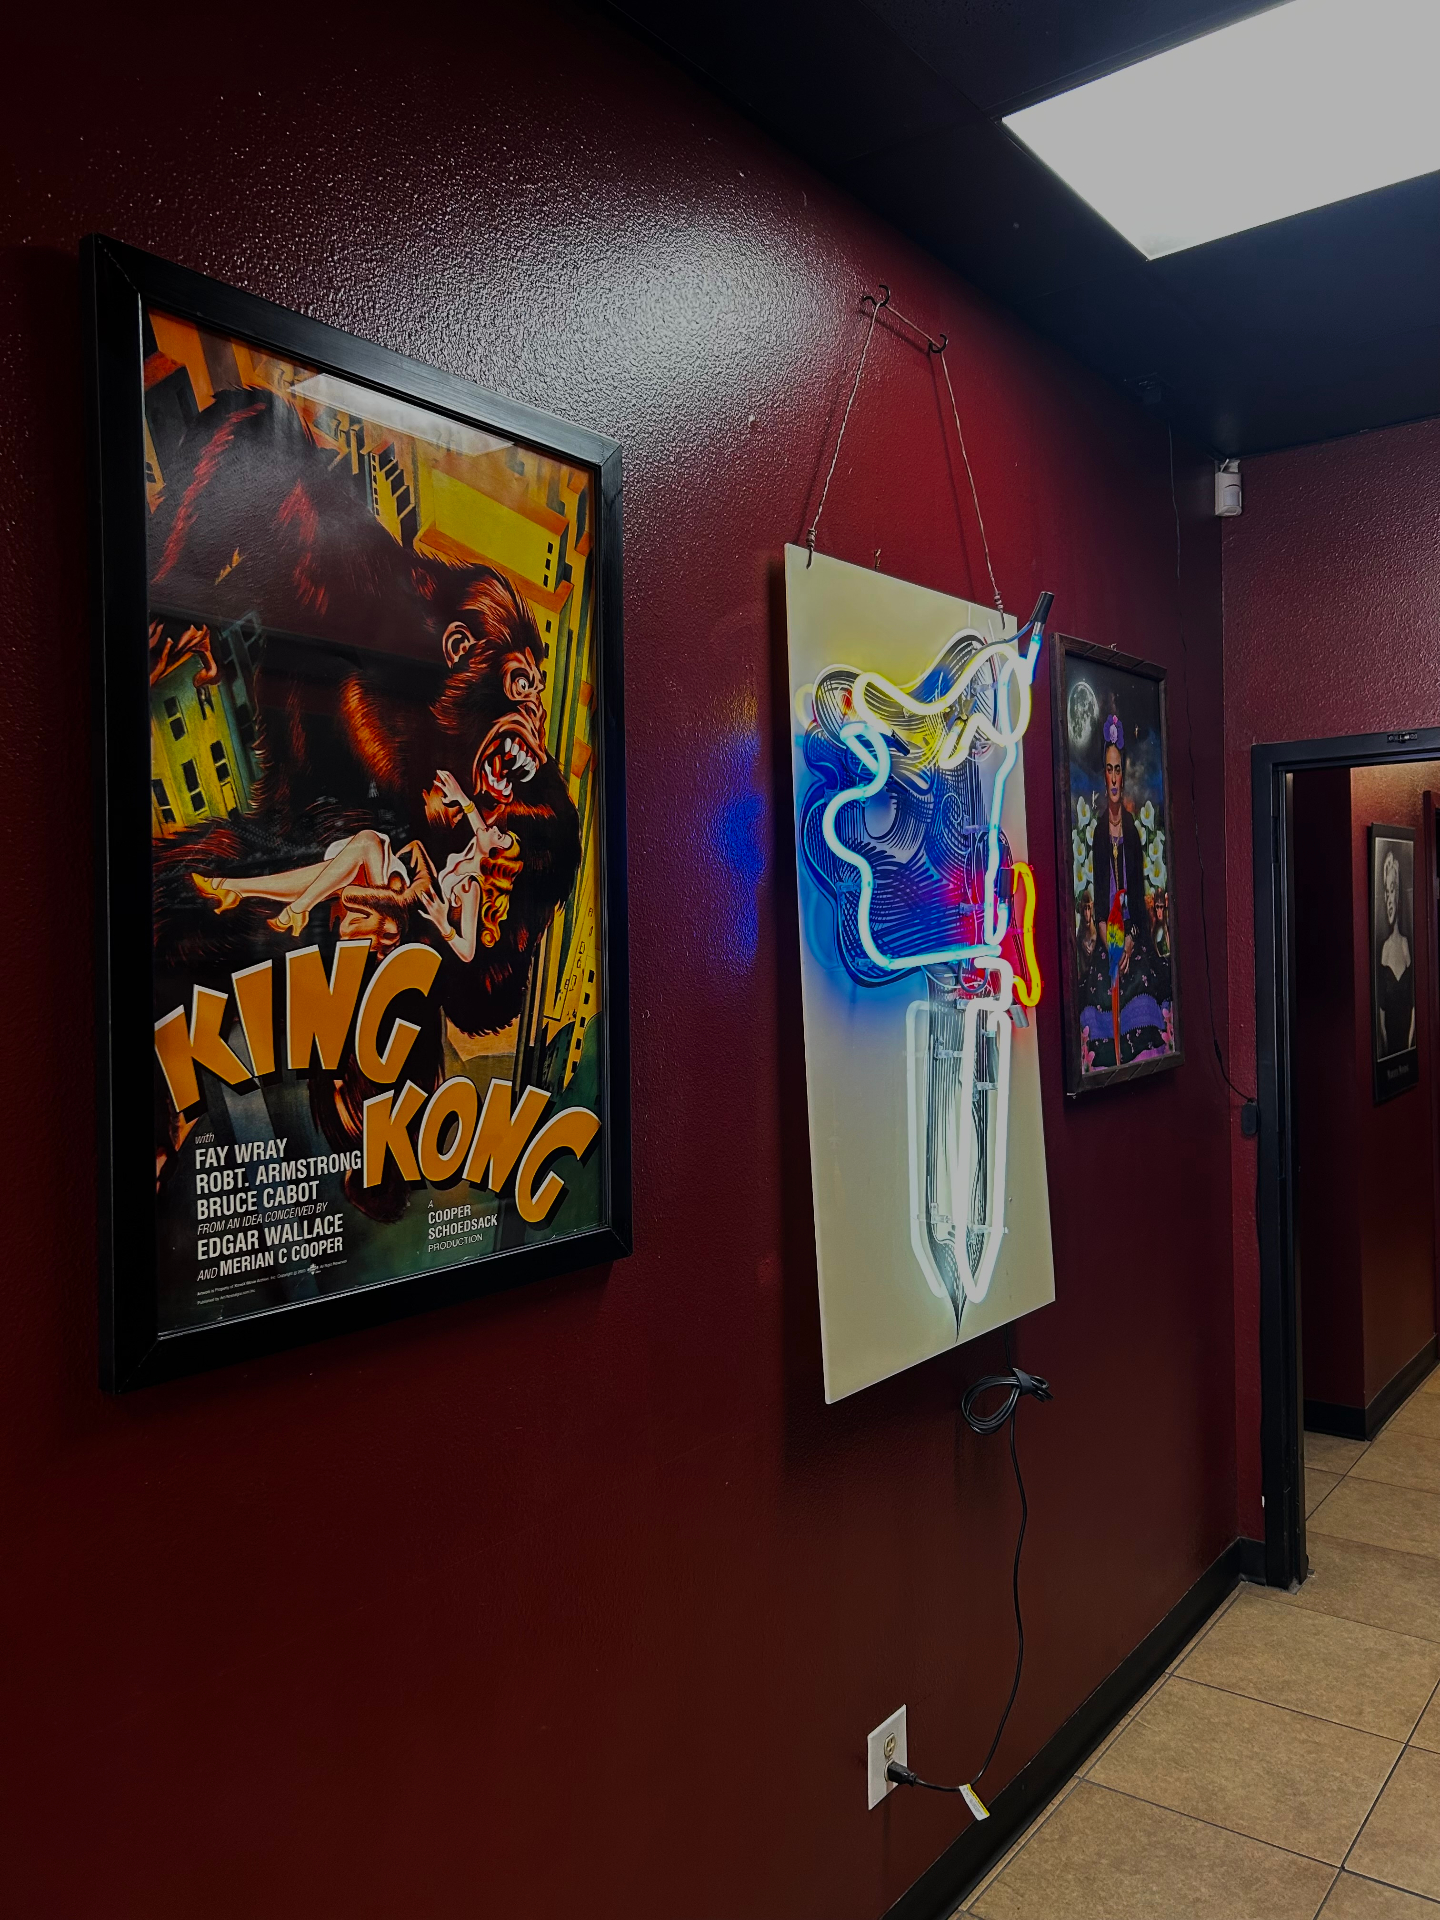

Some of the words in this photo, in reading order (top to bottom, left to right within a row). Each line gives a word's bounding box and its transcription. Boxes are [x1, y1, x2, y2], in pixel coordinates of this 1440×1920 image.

[154, 939, 442, 1113] KING
[195, 1132, 215, 1144] with
[195, 1146, 230, 1170] FAY
[234, 1138, 288, 1164] WRAY
[363, 1075, 602, 1223] KONG
[196, 1167, 249, 1195] ROBT.
[255, 1150, 362, 1186] ARMSTRONG
[197, 1190, 258, 1220] BRUCE
[263, 1181, 320, 1208] CABOT
[428, 1199, 434, 1209] A
[428, 1204, 472, 1225] COOPER
[197, 1220, 226, 1236] FROM
[227, 1219, 241, 1230] AN
[242, 1215, 263, 1227] IDEA
[265, 1206, 315, 1223] CONCEIVED
[316, 1202, 328, 1214] BY
[428, 1214, 498, 1240] SCHOEDSACK
[198, 1230, 259, 1260] EDGAR
[264, 1214, 344, 1247] WALLACE
[428, 1233, 483, 1253] PRODUCTION
[197, 1267, 219, 1281] AND
[220, 1251, 275, 1277] MERIAN
[279, 1249, 288, 1264] C
[292, 1237, 344, 1261] COOPER
